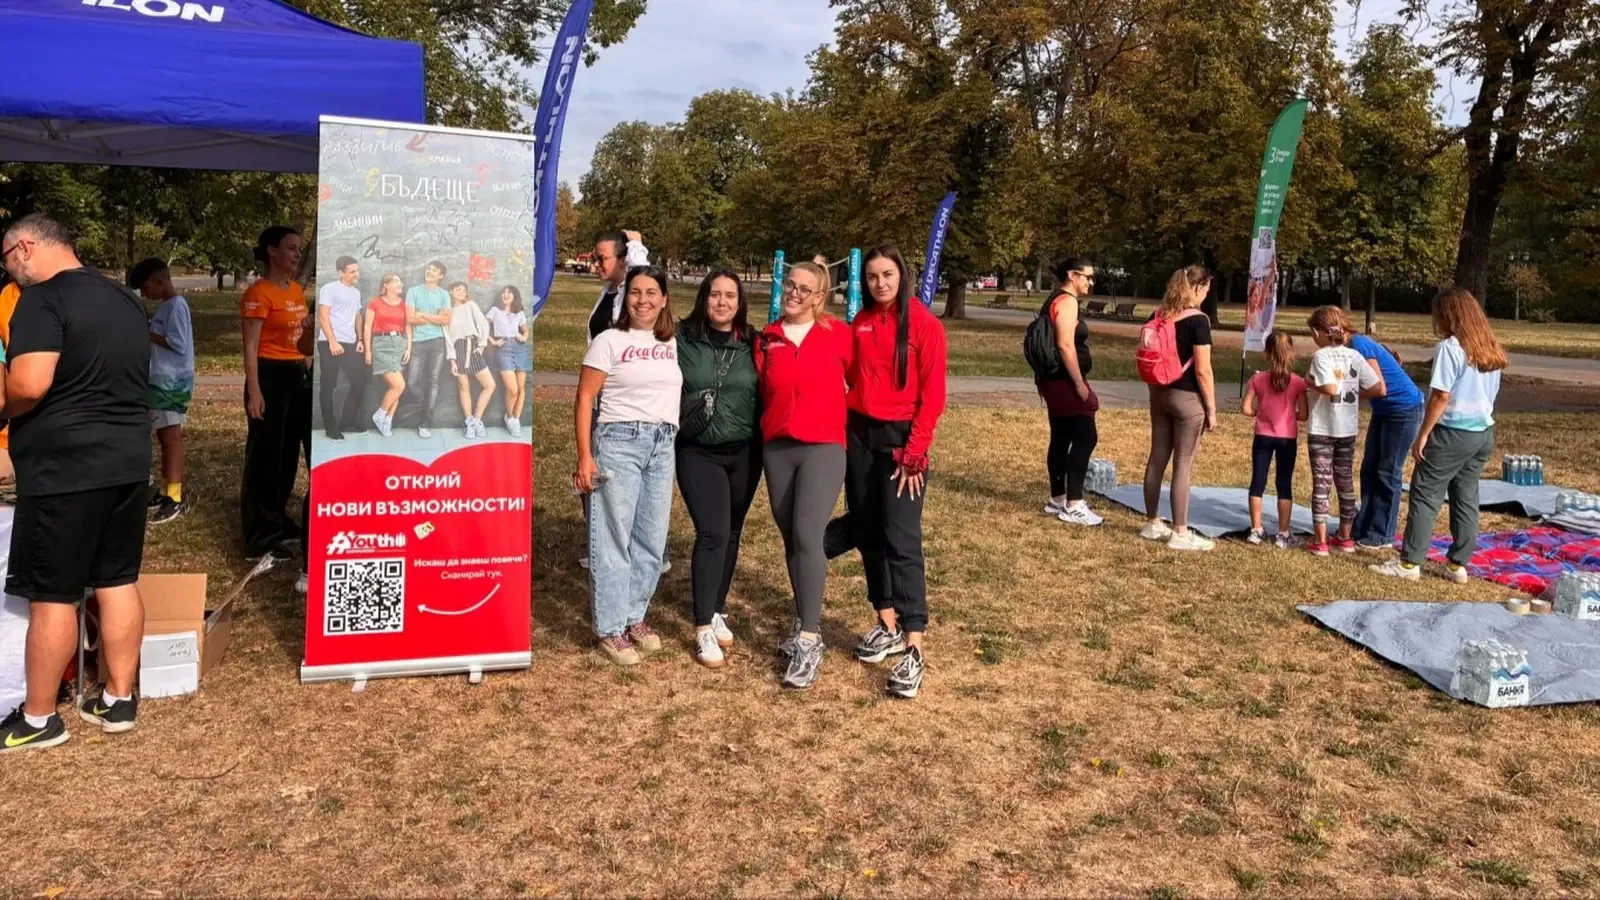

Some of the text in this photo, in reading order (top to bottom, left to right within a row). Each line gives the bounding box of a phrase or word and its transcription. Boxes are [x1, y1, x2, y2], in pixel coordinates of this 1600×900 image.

[381, 173, 480, 205] БЪДЕЩЕ
[332, 214, 384, 230] АМБИЦИИ
[926, 207, 949, 284] DECATHLON
[385, 471, 461, 490] ОТКРИЙ
[317, 497, 525, 517] НОВИ ВЪЗМОЖНОСТИ!
[413, 558, 446, 567] Искаш
[491, 554, 528, 564] повече?
[440, 570, 485, 580] Сканирай
